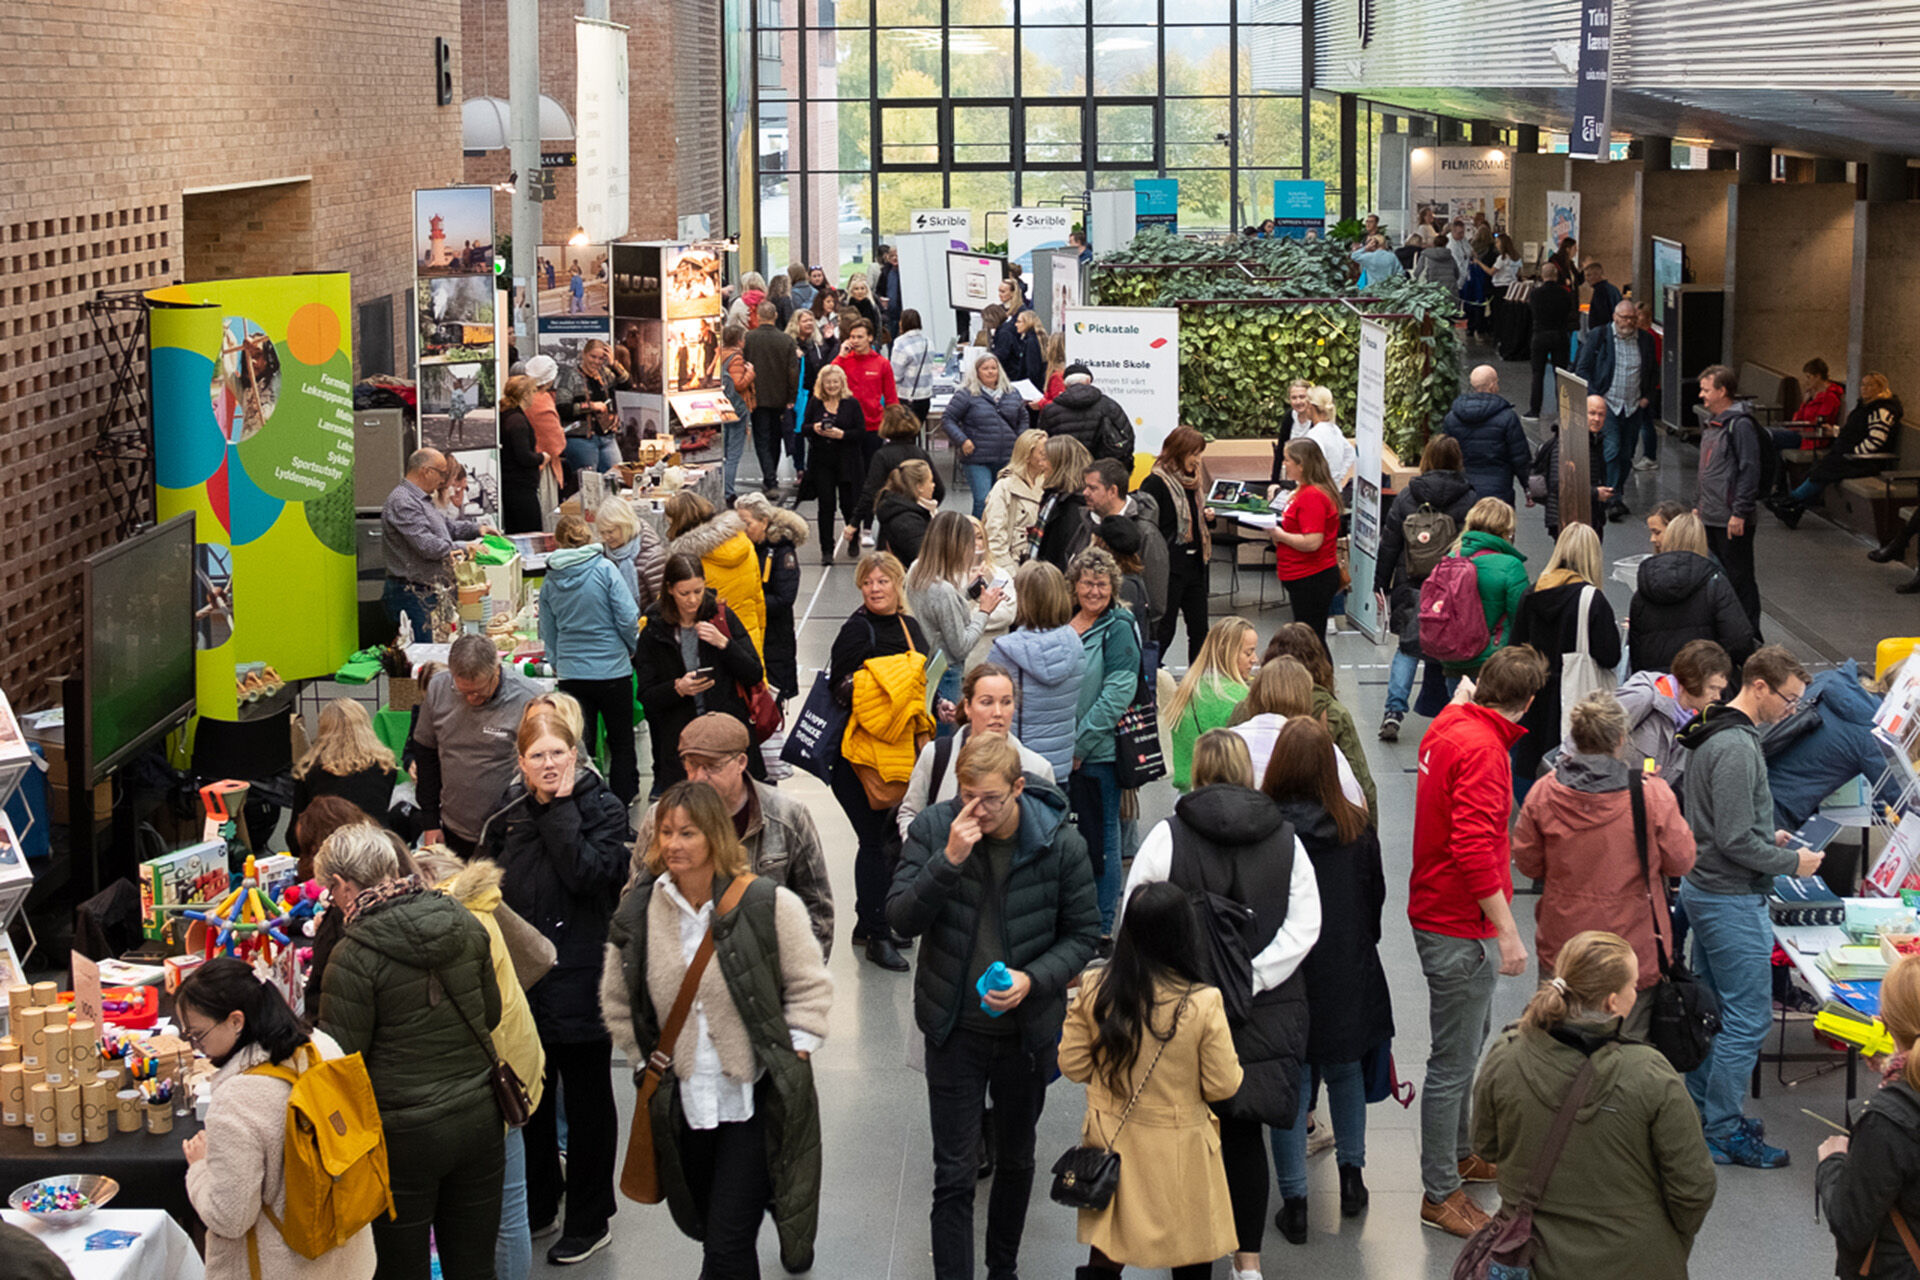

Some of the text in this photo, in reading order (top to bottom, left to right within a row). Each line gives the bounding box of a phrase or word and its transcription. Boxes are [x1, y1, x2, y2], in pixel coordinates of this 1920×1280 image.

[929, 215, 967, 227] Skrible
[1026, 215, 1066, 227] Skrible
[1088, 323, 1140, 334] Pickatale
[1123, 359, 1151, 369] Skole
[320, 373, 351, 394] Forming
[1121, 377, 1129, 385] til
[327, 451, 351, 467] Sykler
[291, 456, 343, 480] Sportsutstyr
[274, 466, 326, 492] Lyddemping
